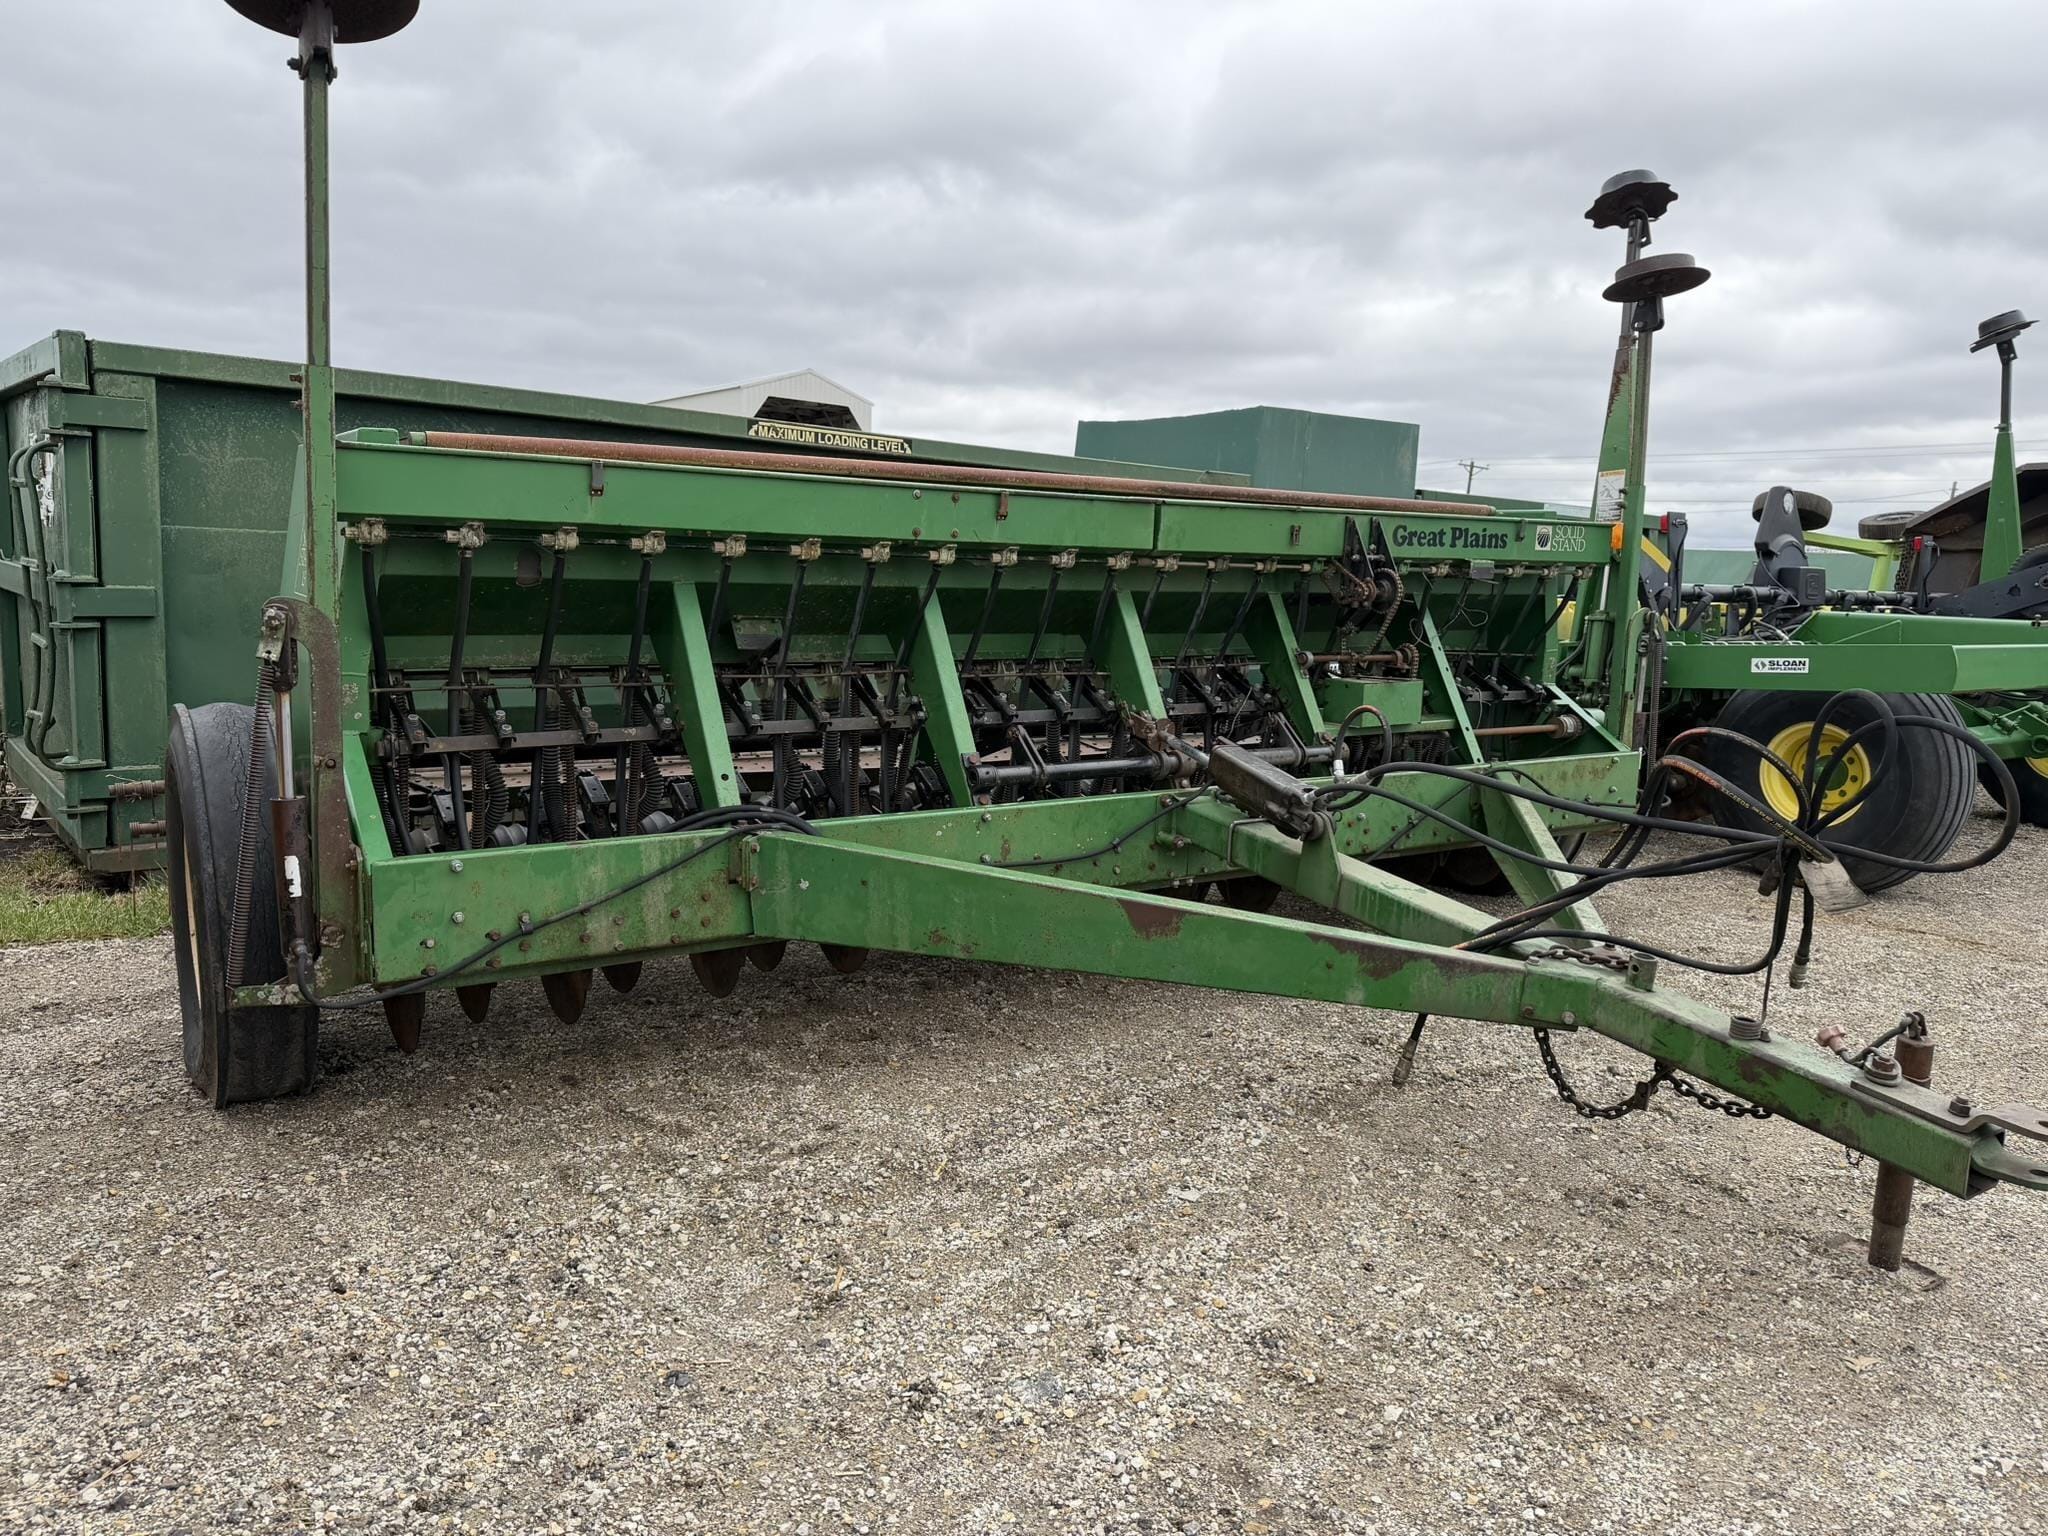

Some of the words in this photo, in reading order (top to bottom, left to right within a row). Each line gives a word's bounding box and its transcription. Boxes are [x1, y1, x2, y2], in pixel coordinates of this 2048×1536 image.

[758, 425, 815, 443] MAXIMUM
[818, 434, 868, 448] LOADING
[871, 440, 905, 453] LEVEL
[1392, 525, 1447, 547] Great
[1450, 527, 1508, 549] Plains
[1555, 524, 1585, 539] SOLID
[1552, 538, 1586, 552] STAND
